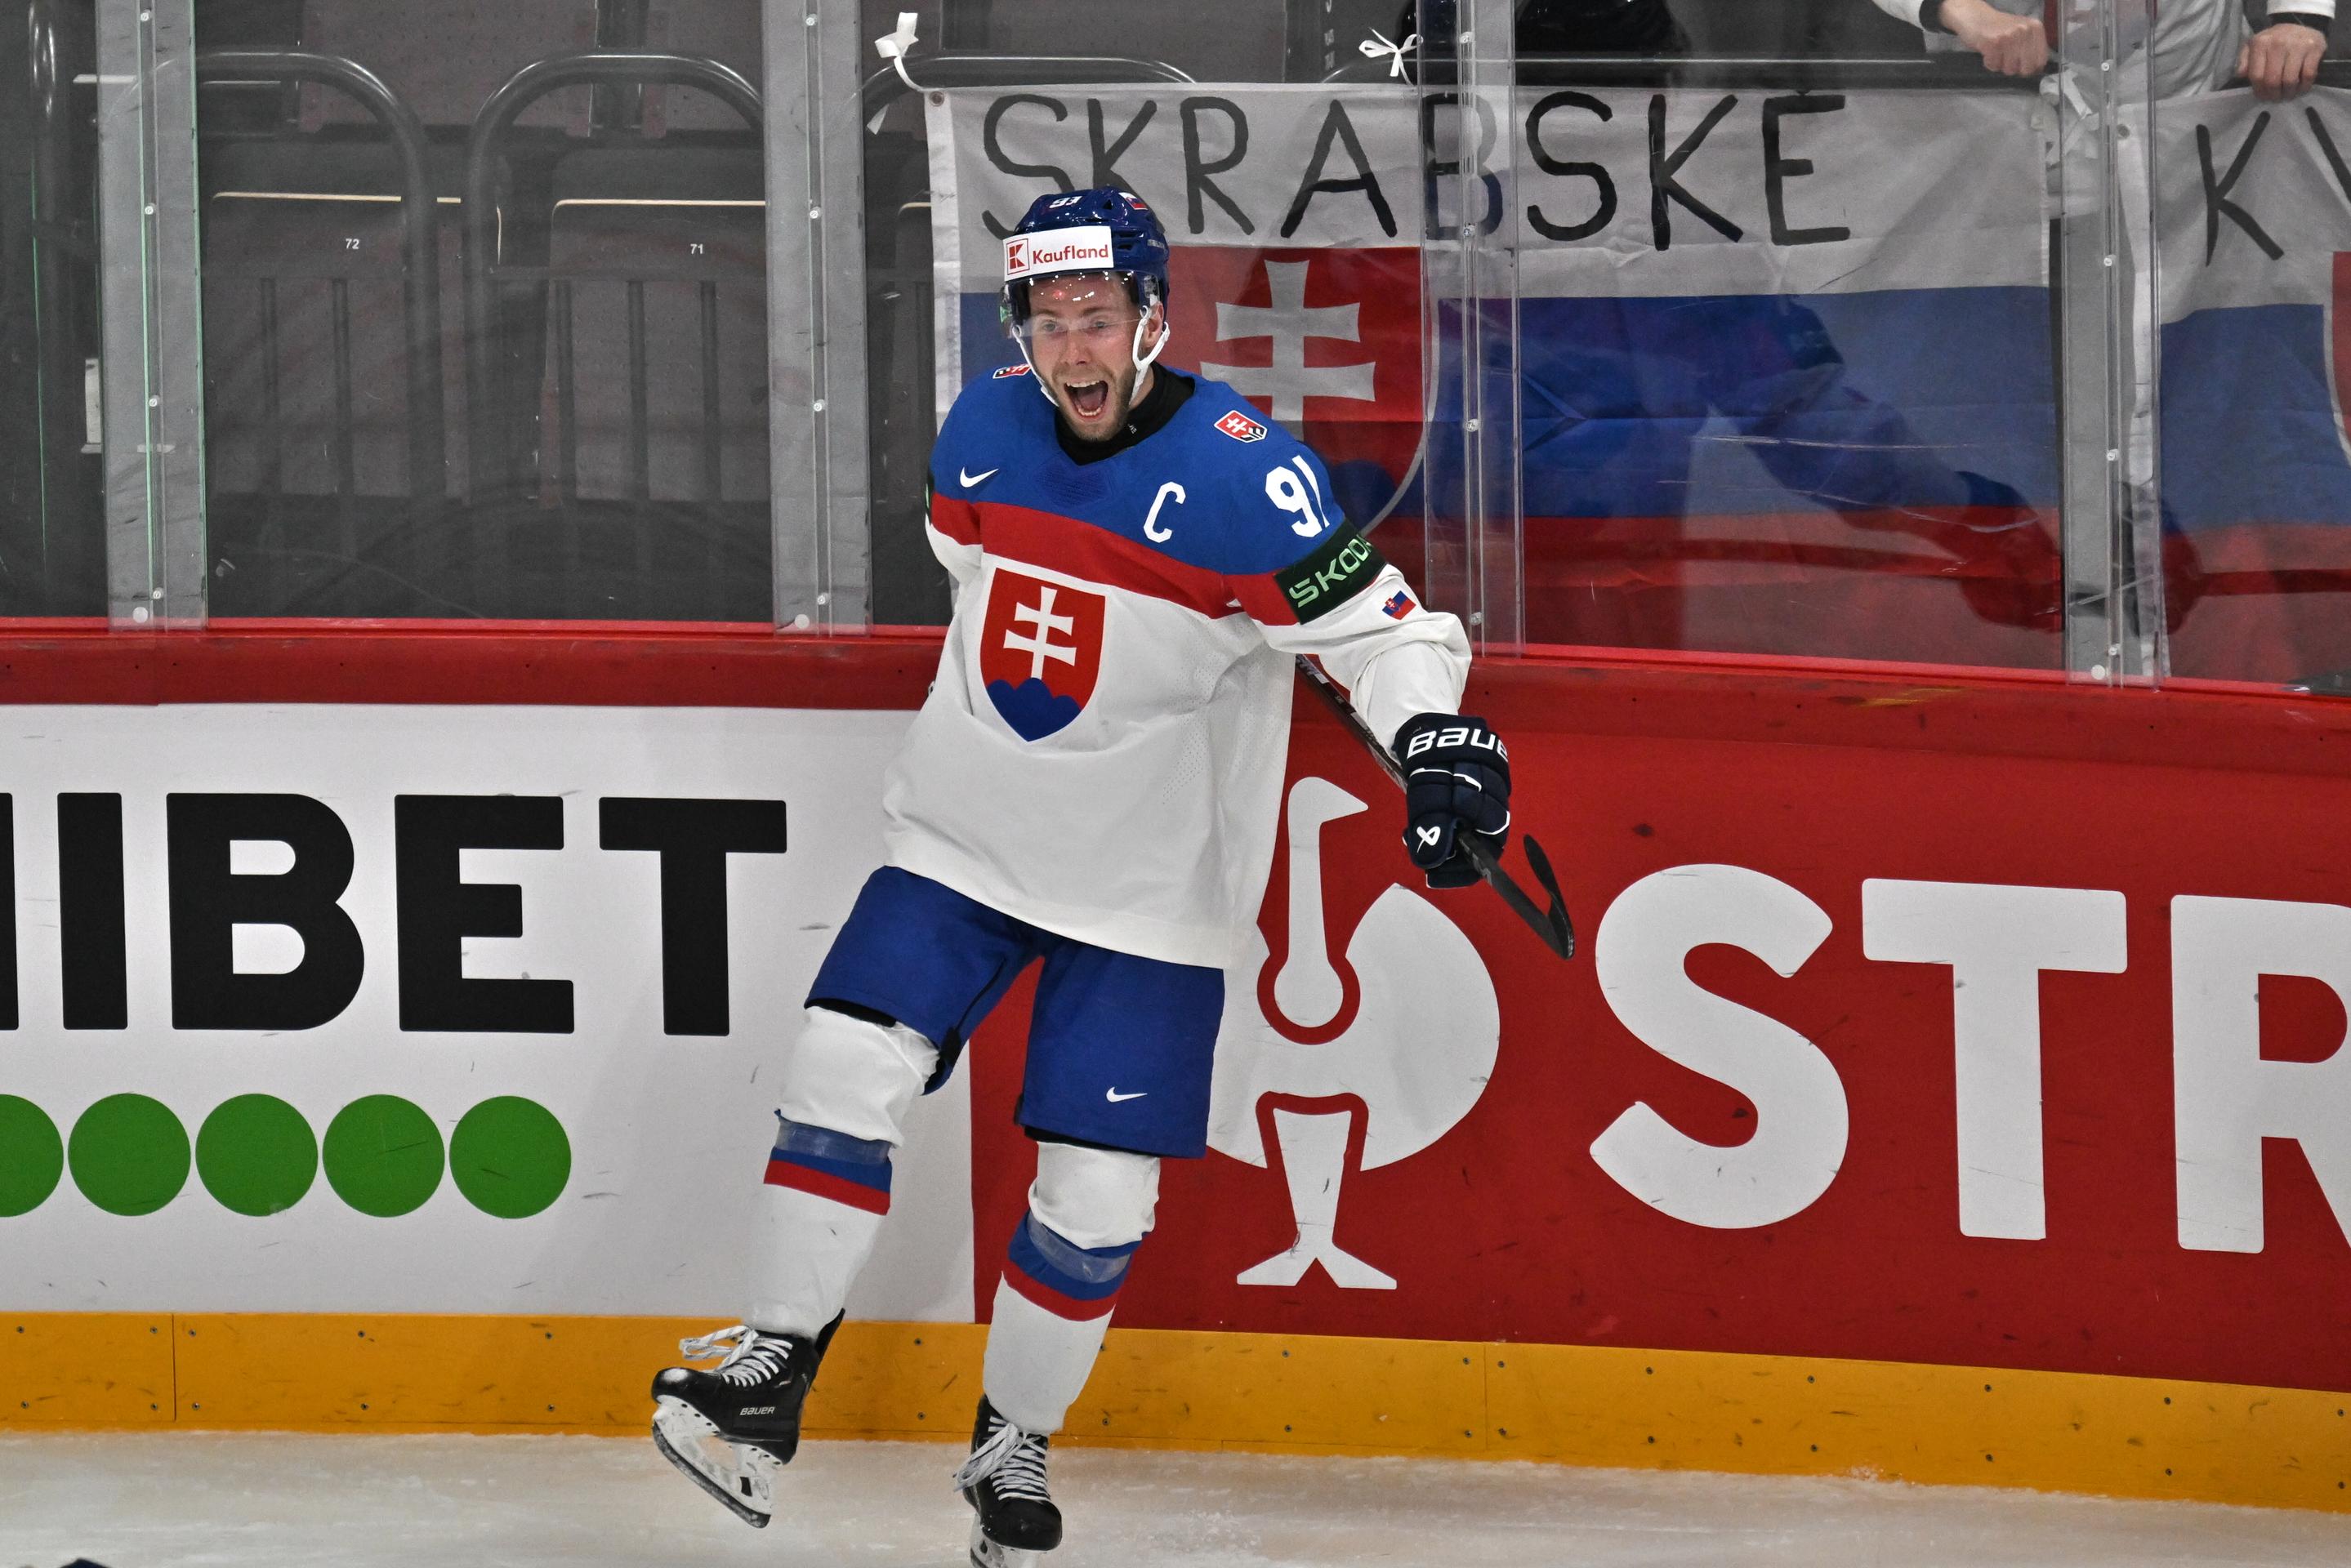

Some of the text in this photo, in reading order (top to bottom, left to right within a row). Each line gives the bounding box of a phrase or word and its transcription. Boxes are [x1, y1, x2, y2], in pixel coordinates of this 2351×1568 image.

[346, 238, 359, 249] 72
[690, 243, 703, 254] 71
[1033, 244, 1109, 265] Kaufland
[1144, 482, 1186, 543] C
[1407, 728, 1509, 762] BAUE
[0, 792, 787, 1036] IBET
[1590, 863, 2351, 1253] STR
[739, 1406, 775, 1416] BAUER
